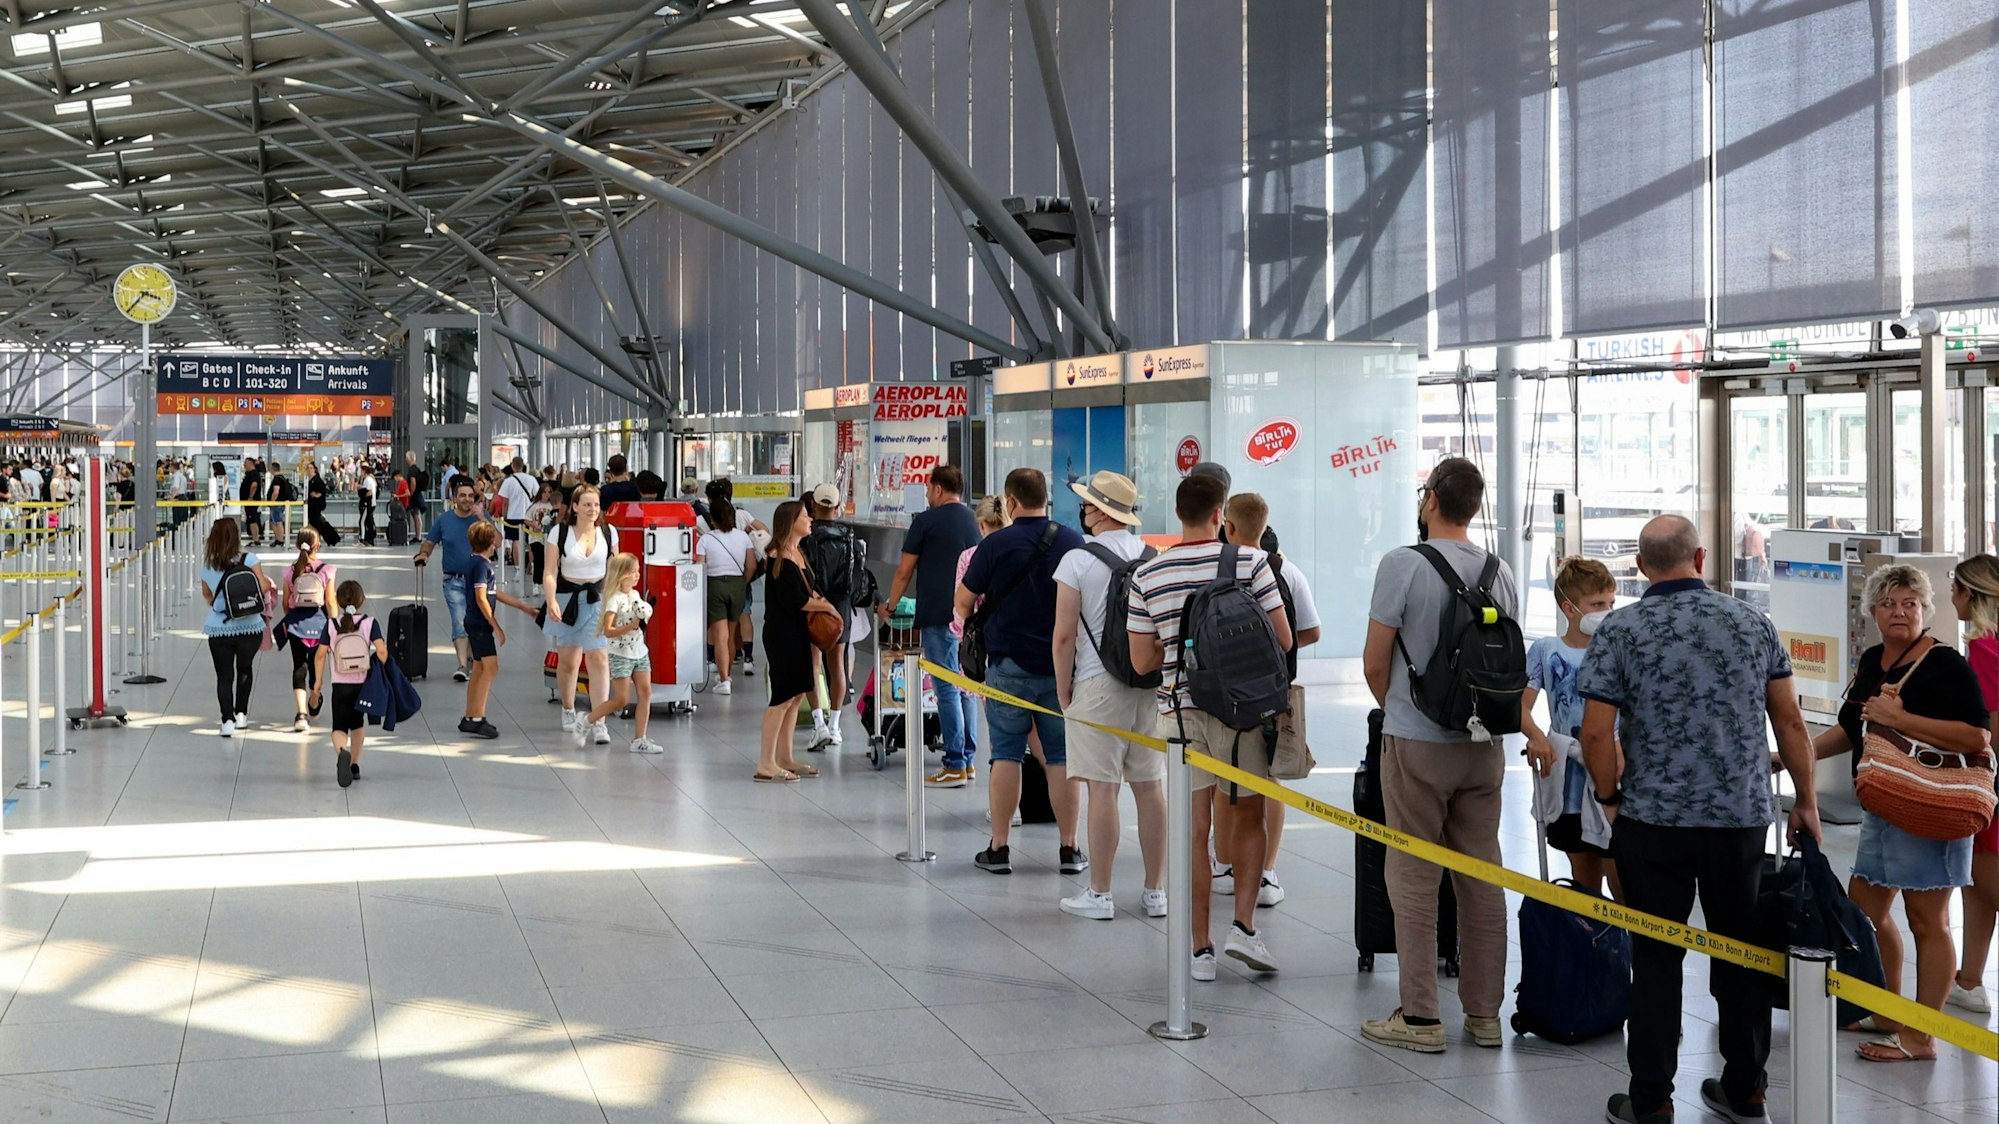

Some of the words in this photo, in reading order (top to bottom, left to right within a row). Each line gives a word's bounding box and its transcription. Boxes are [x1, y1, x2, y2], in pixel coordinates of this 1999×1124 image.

[1586, 337, 1664, 360] TURKISH
[202, 363, 233, 374] Gates
[245, 364, 292, 375] Check-in
[328, 365, 369, 376] Ankunft
[1158, 357, 1192, 374] SunExpress
[1079, 366, 1107, 381] SunExpress
[203, 378, 209, 388] B
[213, 378, 219, 388] C
[223, 378, 230, 388] D
[245, 378, 288, 389] 101-320
[328, 379, 368, 390] Arrivals
[836, 388, 861, 402] AEROPLAN
[873, 386, 967, 401] AEROPLAN
[873, 404, 967, 418] AEROPLAN
[875, 434, 905, 443] Weltweit
[906, 434, 931, 445] fliegen
[238, 600, 257, 610] PUMA
[1792, 663, 1826, 673] ABAKWAREN
[1610, 908, 1623, 920] Köln
[1624, 912, 1640, 926] Bonn
[1641, 917, 1665, 934] Airport
[1708, 938, 1724, 951] Köln
[1725, 943, 1742, 957] Bonn
[1744, 948, 1770, 966] Airport
